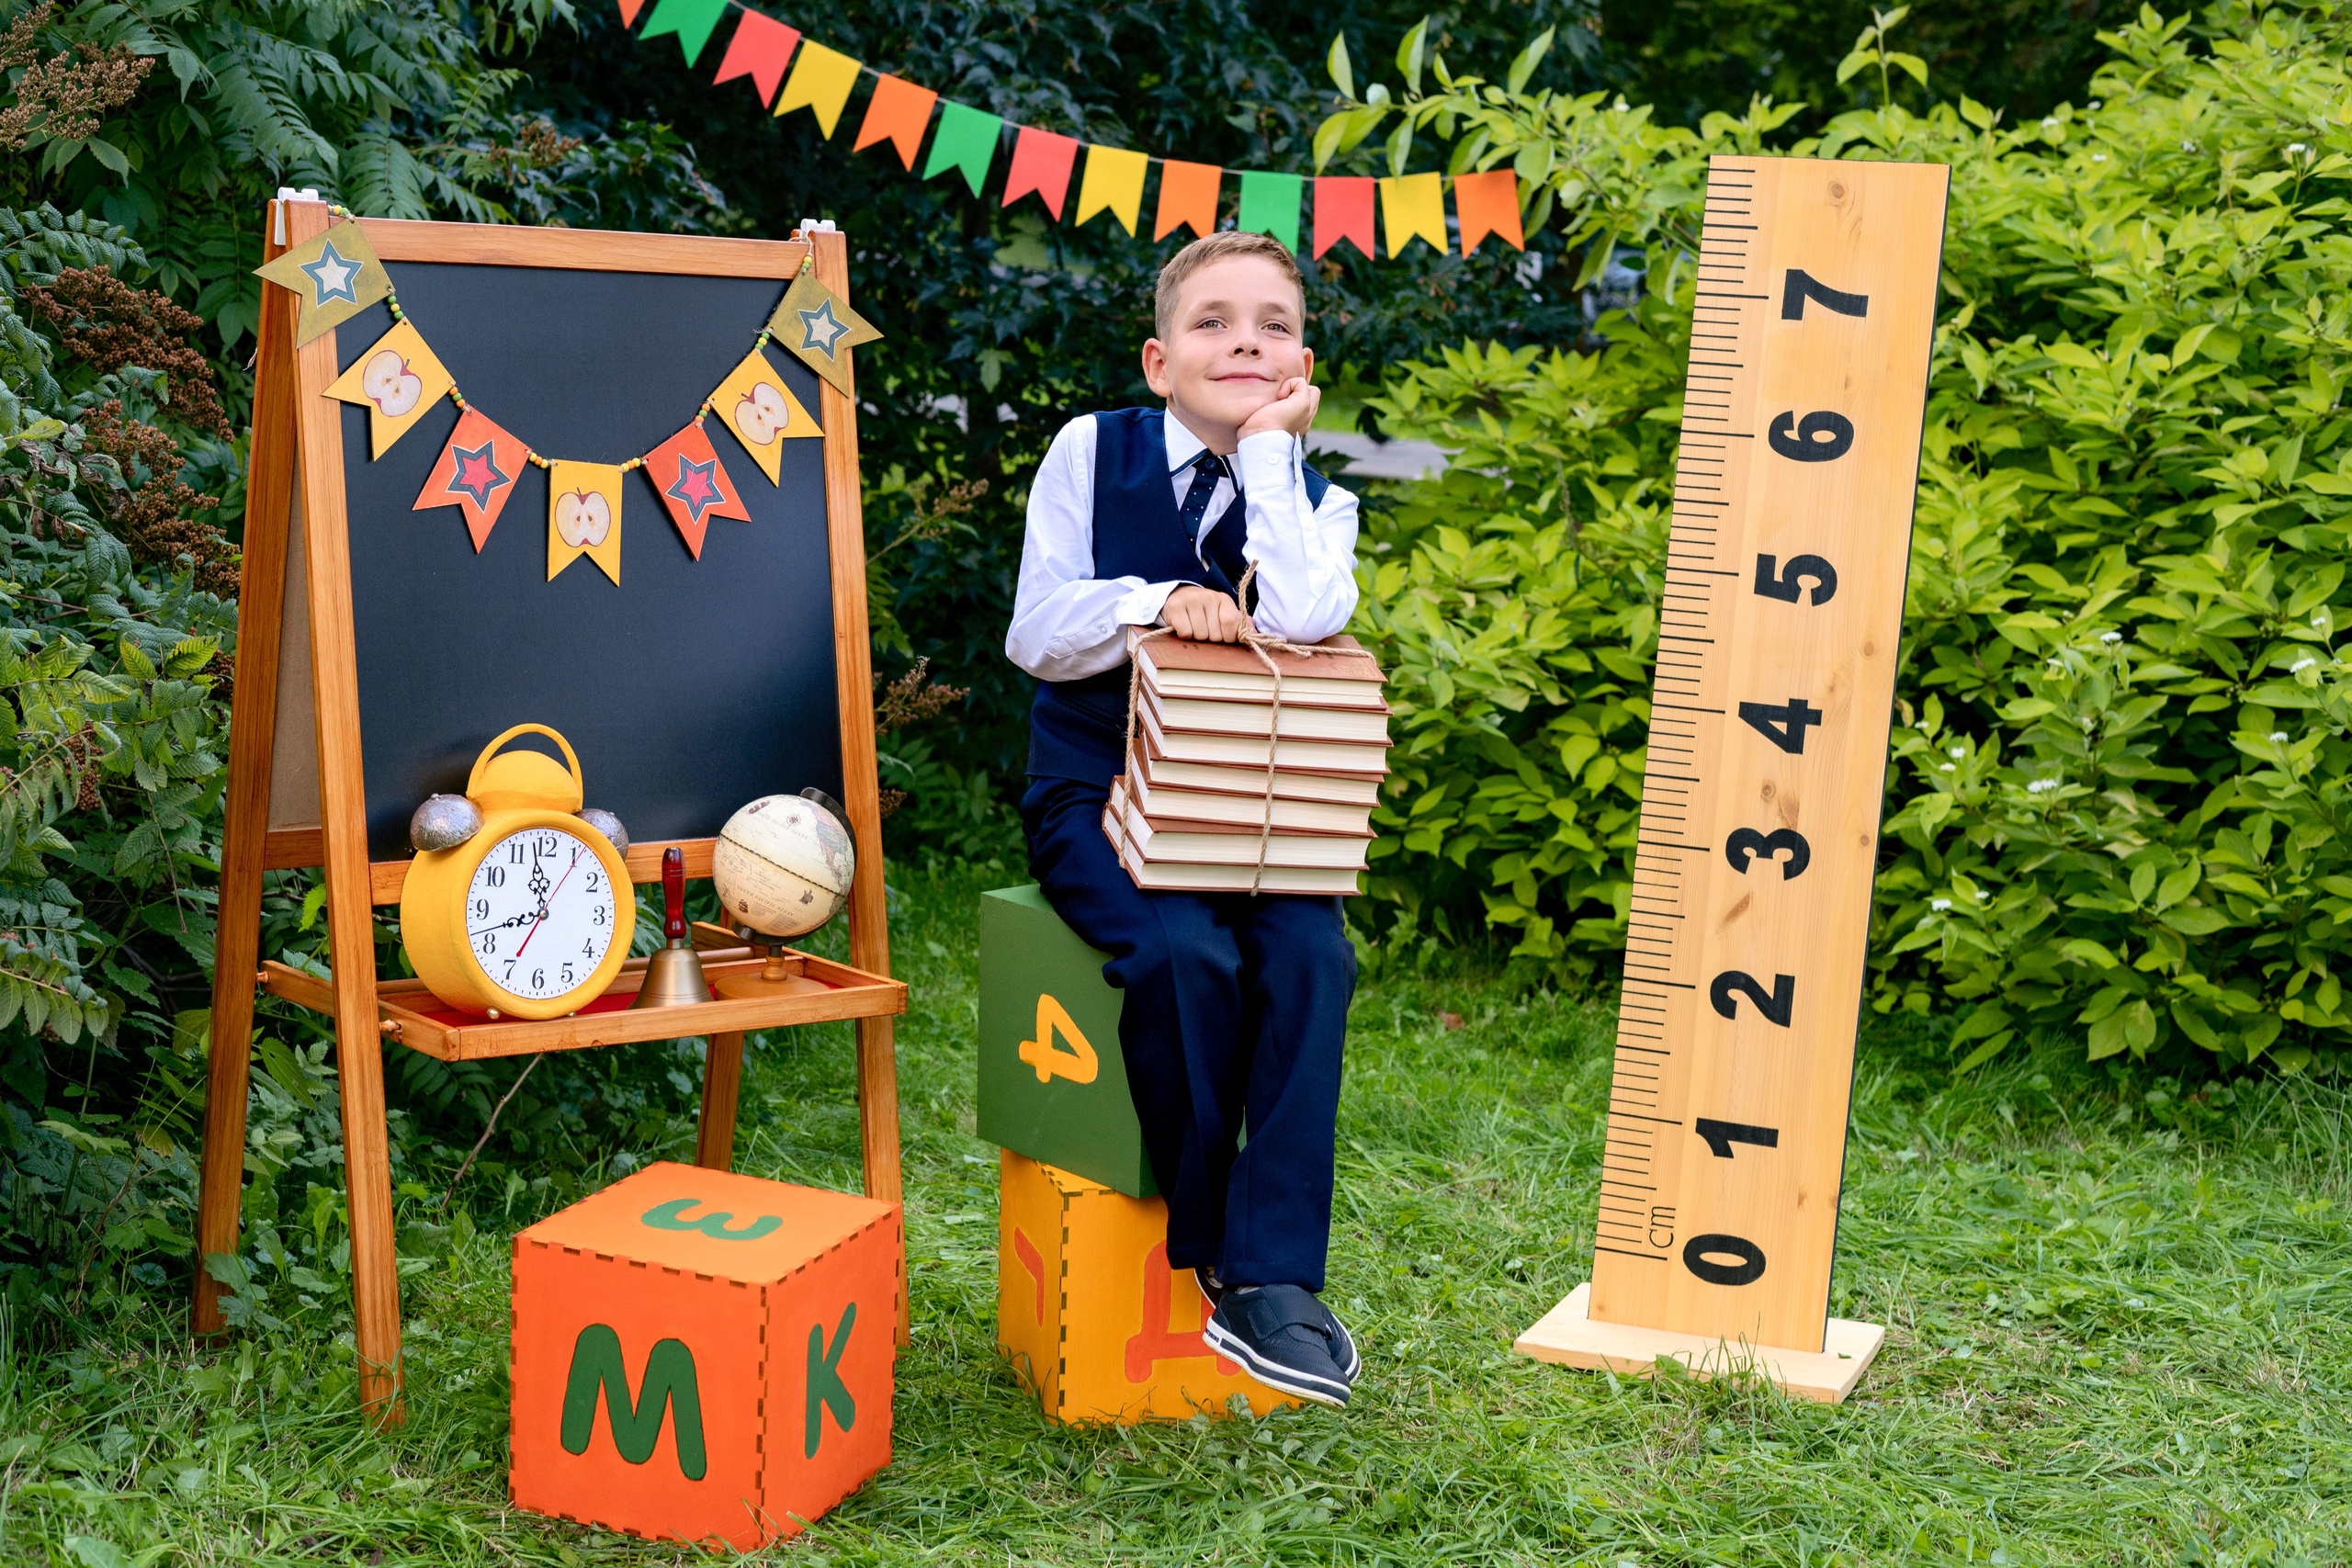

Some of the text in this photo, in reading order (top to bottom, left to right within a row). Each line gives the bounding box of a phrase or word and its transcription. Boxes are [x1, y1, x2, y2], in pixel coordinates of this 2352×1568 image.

[1781, 268, 1869, 321] 7
[1768, 410, 1854, 463] 6
[1753, 553, 1838, 607] 5
[1737, 697, 1823, 755] 4
[508, 842, 526, 864] 11
[537, 836, 558, 858] 12
[569, 847, 578, 868] 1
[1724, 827, 1810, 881] 3
[485, 865, 505, 887] 10
[585, 872, 598, 893] 2
[476, 898, 490, 920] 9
[593, 905, 605, 926] 3
[482, 932, 496, 954] 8
[582, 938, 595, 959] 4
[503, 959, 516, 980] 7
[531, 967, 545, 990] 6
[560, 962, 573, 983] 5
[1709, 969, 1795, 1029] 2
[1018, 993, 1099, 1085] 4
[1695, 1116, 1780, 1159] 1
